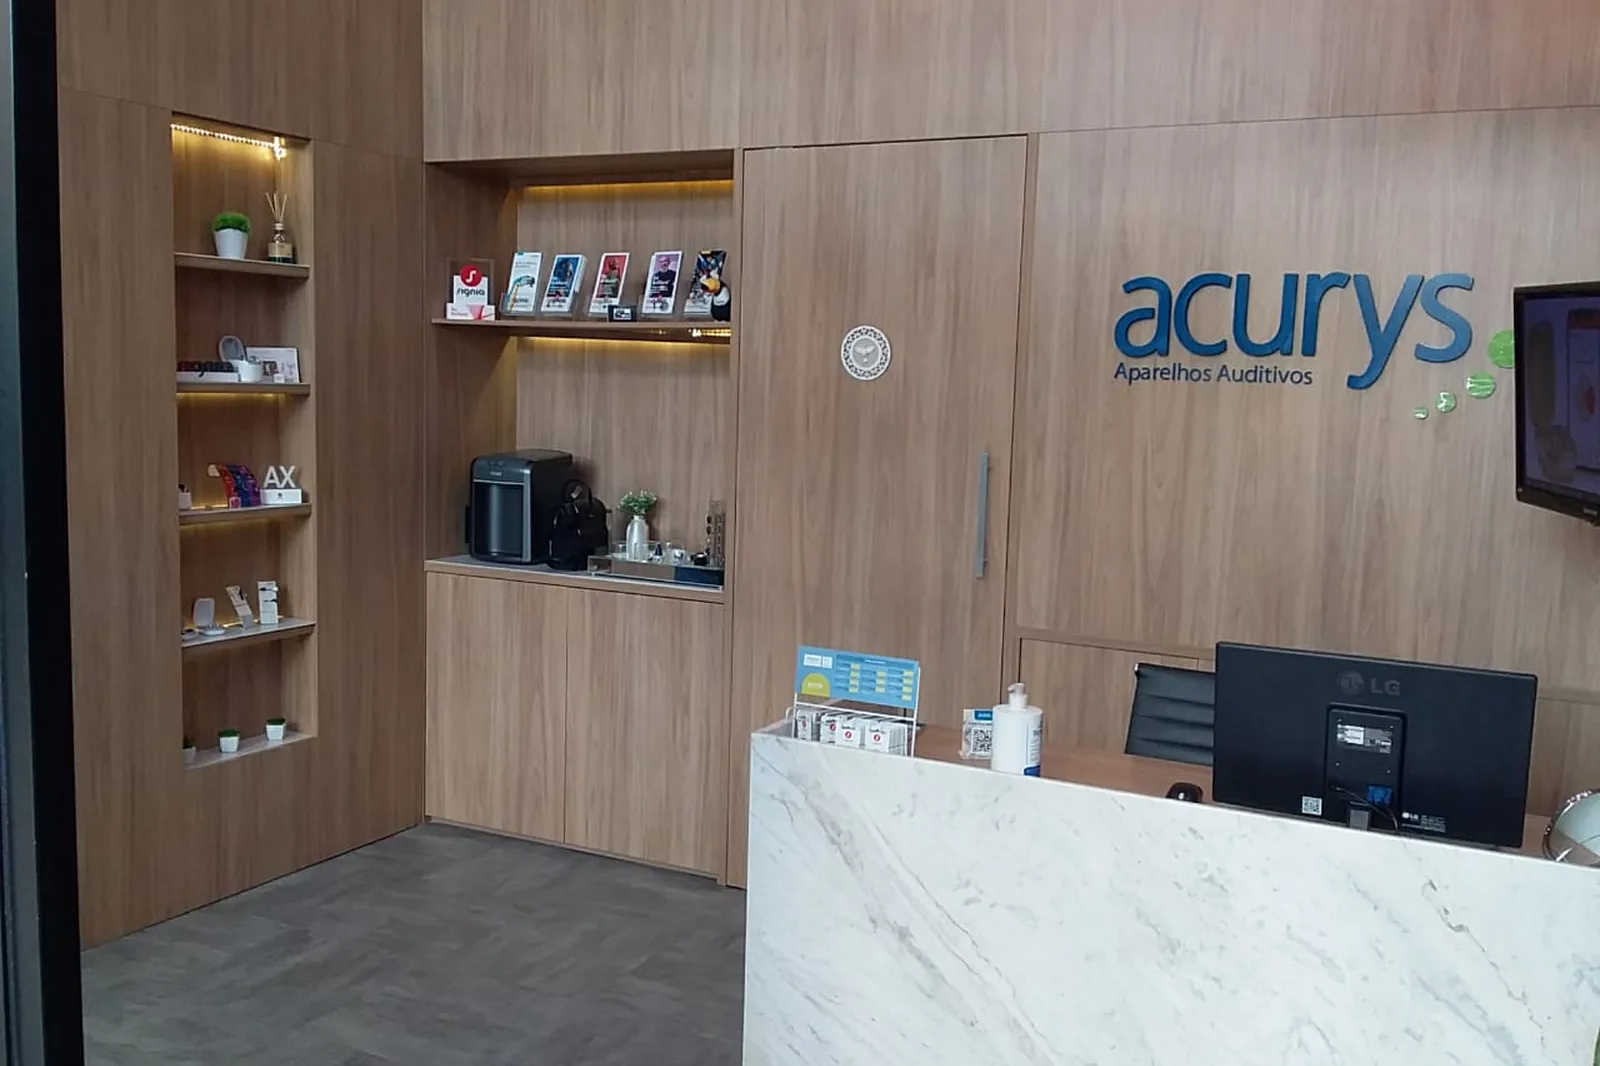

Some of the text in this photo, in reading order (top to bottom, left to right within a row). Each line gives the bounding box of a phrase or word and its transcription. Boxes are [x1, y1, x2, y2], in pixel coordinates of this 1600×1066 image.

[1114, 272, 1474, 390] acurys
[1114, 362, 1313, 386] Aparelhos Auditivos
[263, 465, 296, 488] AX
[1371, 677, 1401, 696] LG
